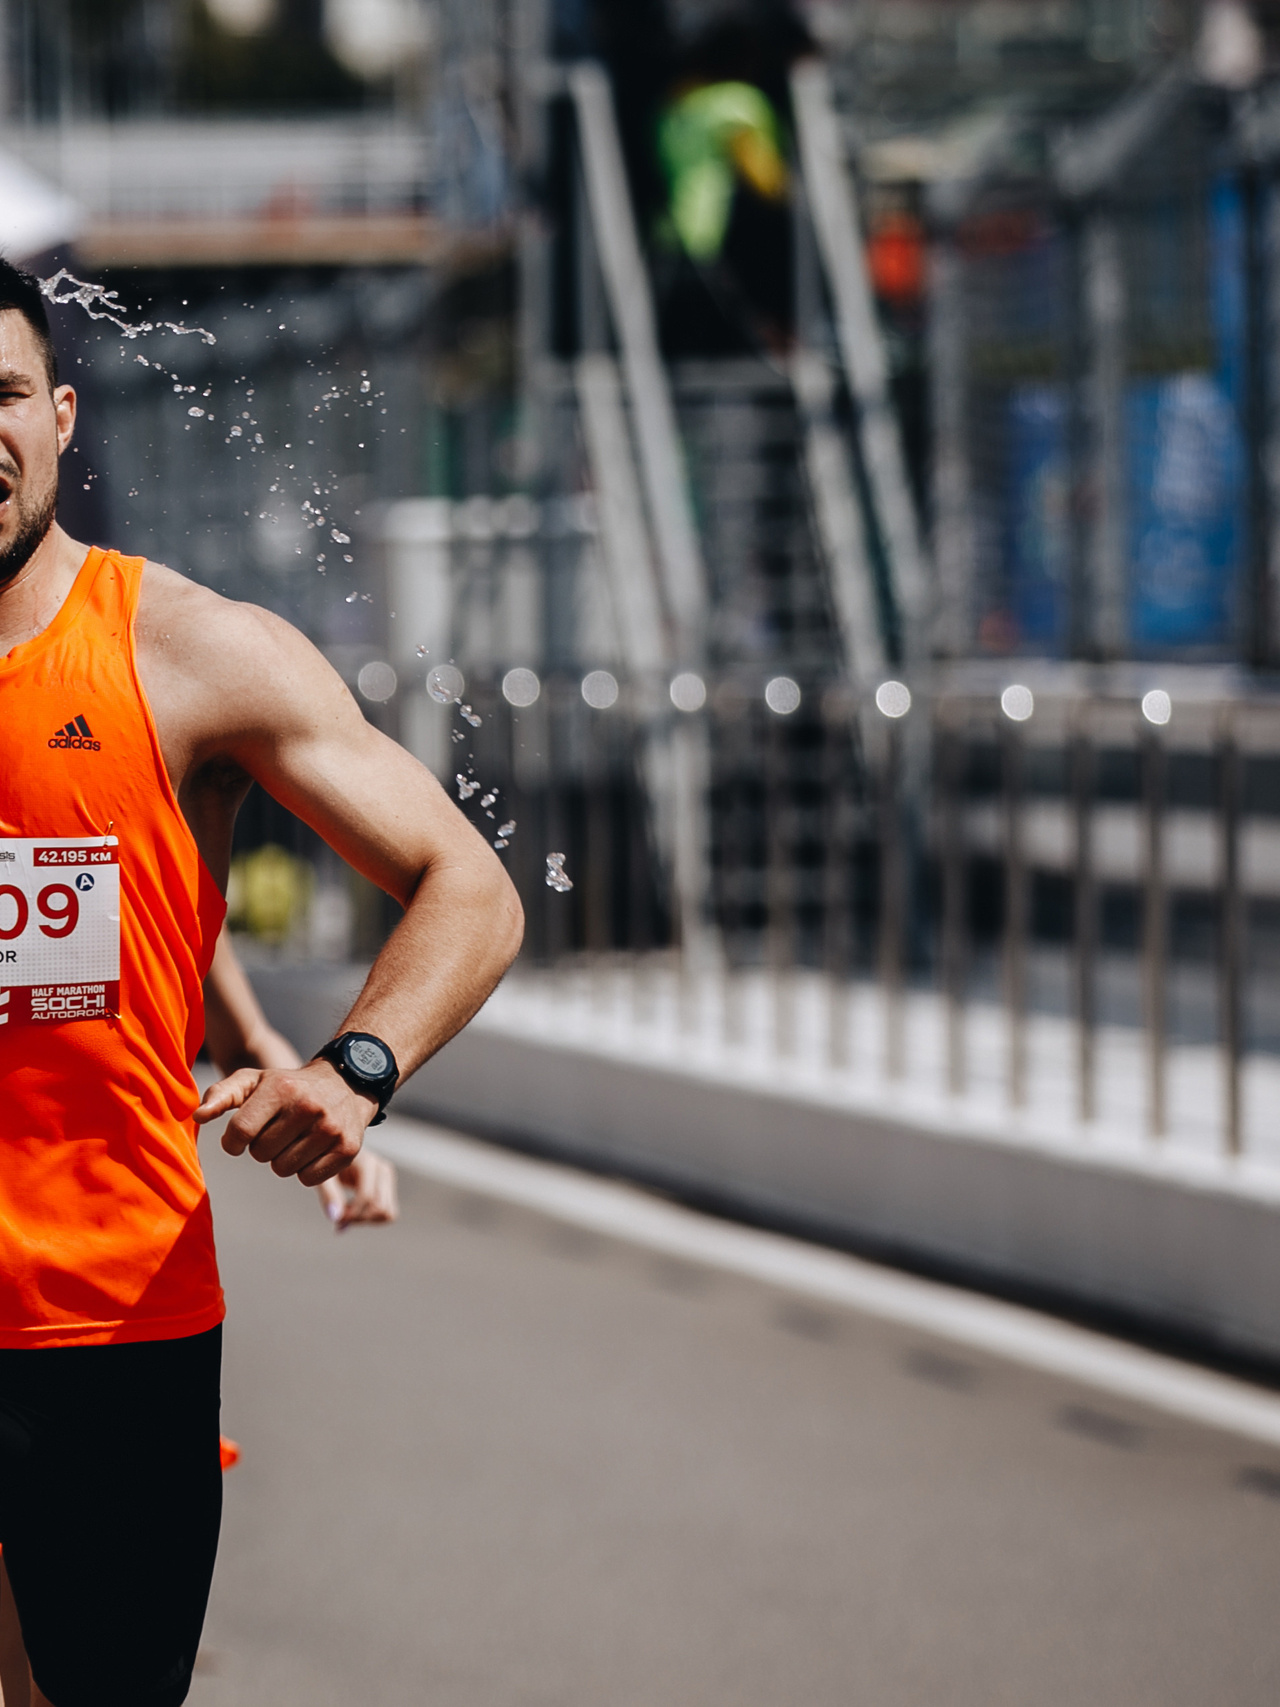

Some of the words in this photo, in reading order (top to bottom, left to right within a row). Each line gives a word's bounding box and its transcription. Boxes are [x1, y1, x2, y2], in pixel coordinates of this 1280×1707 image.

[48, 736, 101, 751] adidas
[38, 850, 87, 863] 42.195
[31, 987, 54, 997] HALF
[56, 984, 106, 996] MARATHON
[31, 994, 106, 1012] SOCHI
[31, 1008, 105, 1020] AUTODROM
